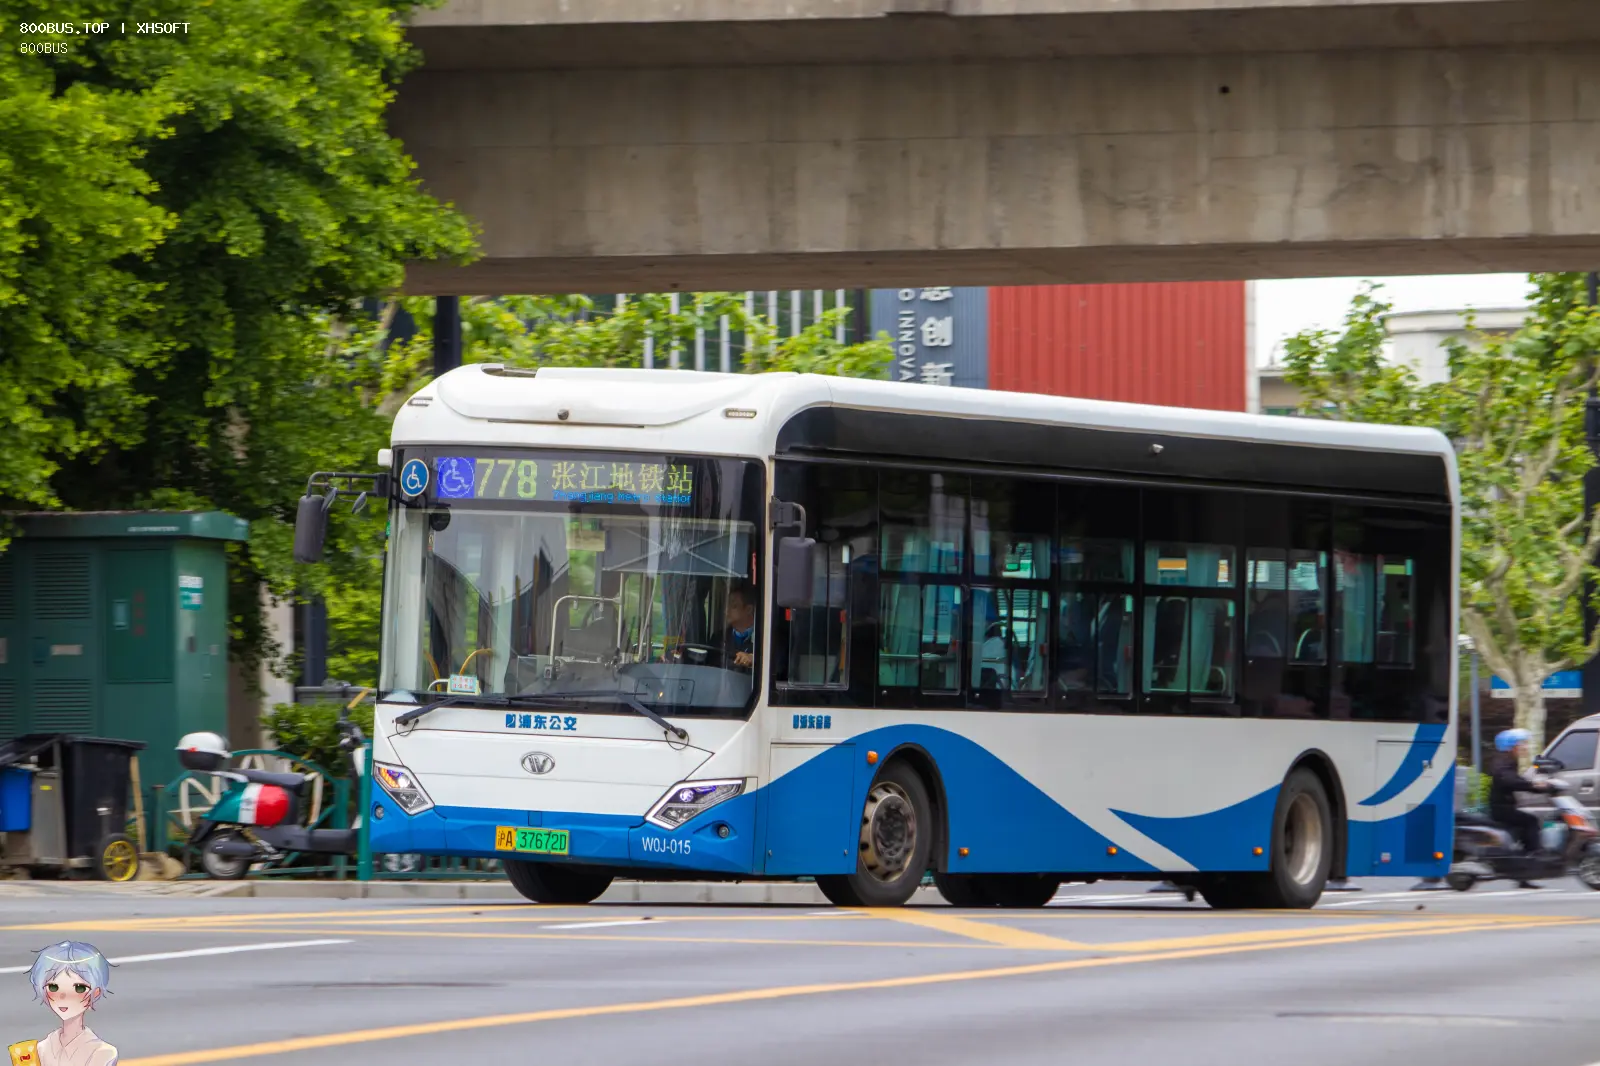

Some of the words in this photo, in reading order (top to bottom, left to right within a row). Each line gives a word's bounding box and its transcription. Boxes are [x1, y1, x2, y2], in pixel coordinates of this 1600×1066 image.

[476, 458, 538, 498] 778
[551, 461, 693, 494] 张江地铁站
[552, 490, 614, 504] Zhangjiang
[518, 714, 577, 731] 浦东公交
[519, 831, 567, 850] 37672D
